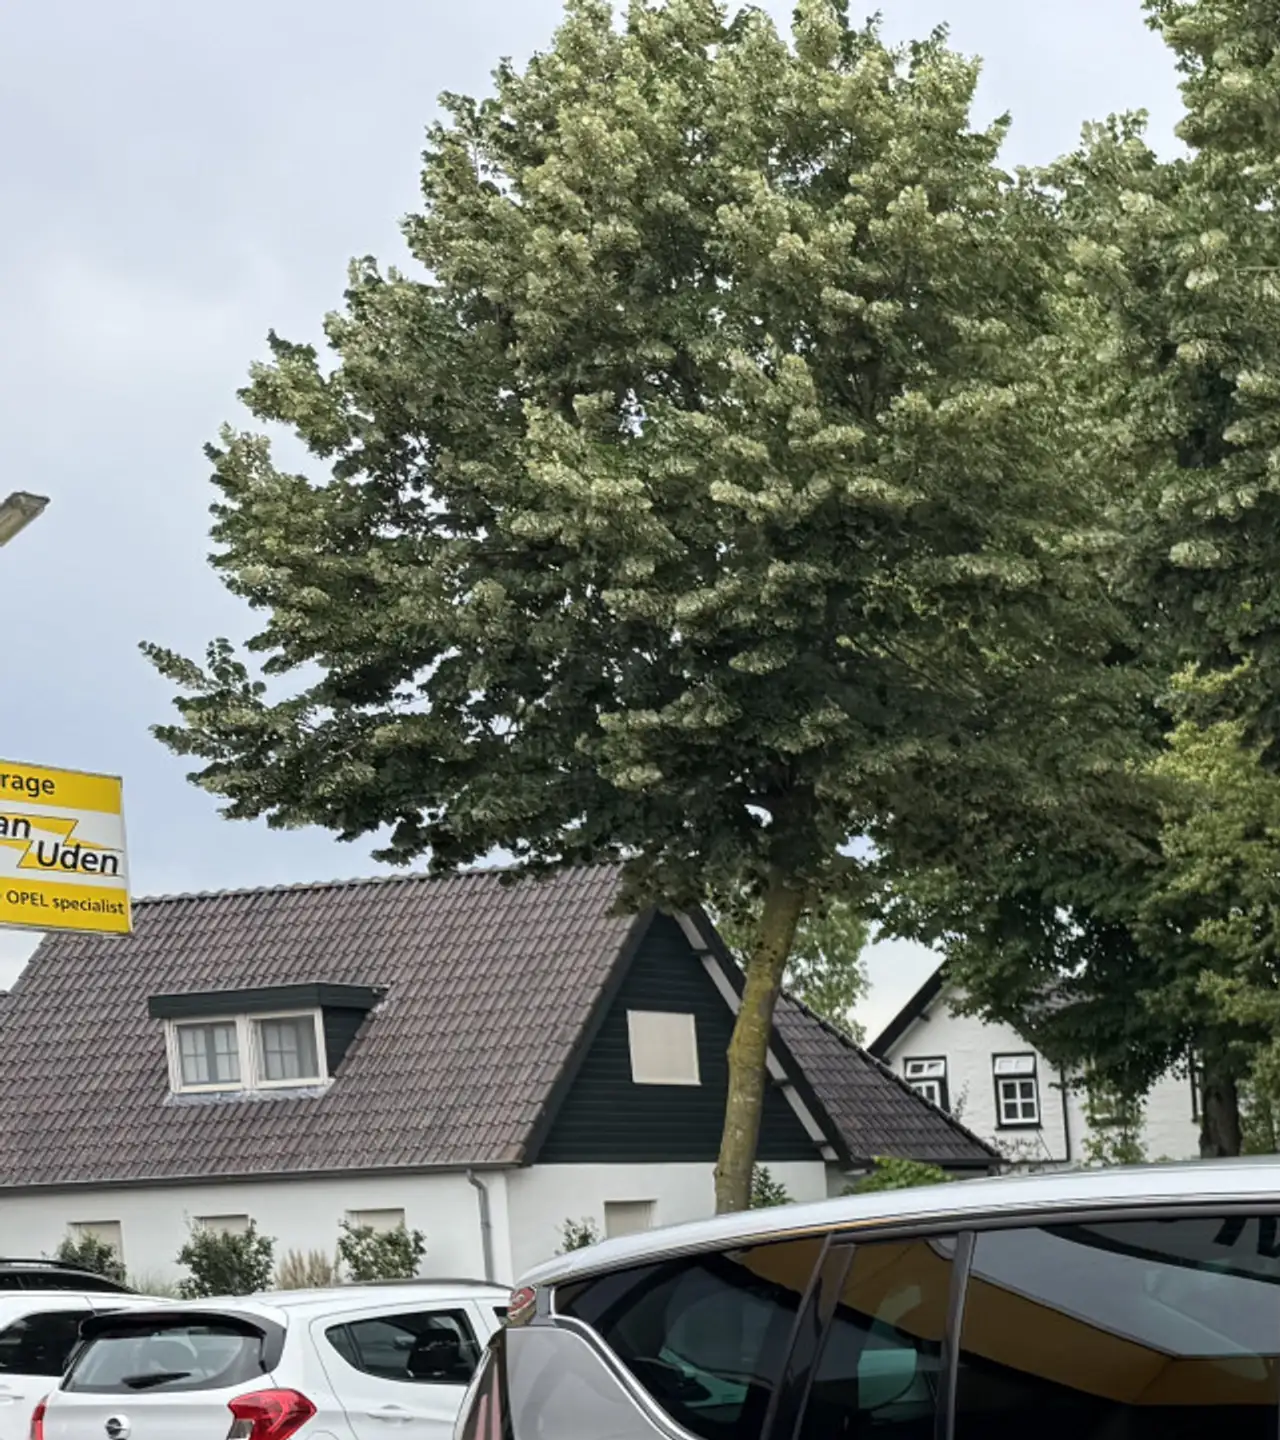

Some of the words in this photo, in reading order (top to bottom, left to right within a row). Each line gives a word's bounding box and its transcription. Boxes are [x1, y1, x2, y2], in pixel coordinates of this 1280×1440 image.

[37, 840, 118, 875] Uden
[6, 889, 48, 907] OPEL
[52, 897, 125, 915] specialist
